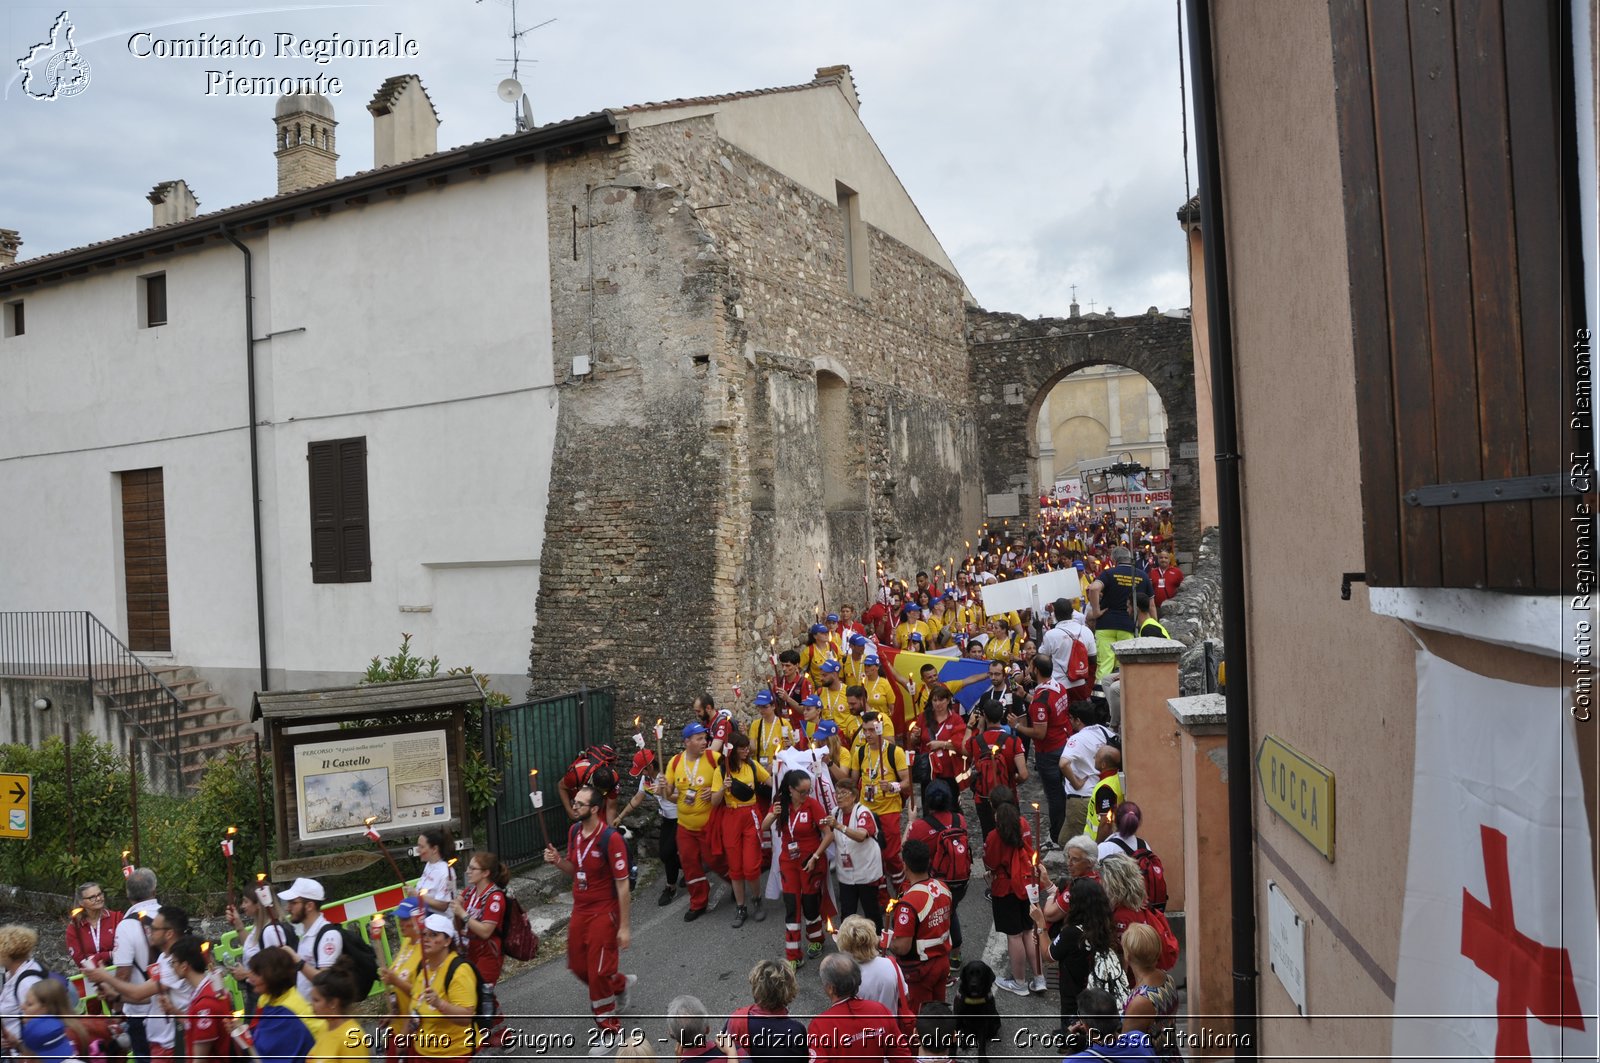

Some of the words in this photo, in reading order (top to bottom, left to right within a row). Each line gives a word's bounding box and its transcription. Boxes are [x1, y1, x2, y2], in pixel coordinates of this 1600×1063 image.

[1094, 493, 1142, 504] COMITATO
[322, 760, 330, 769] Il
[332, 756, 371, 768] Castello
[1272, 756, 1318, 830] ROCCA
